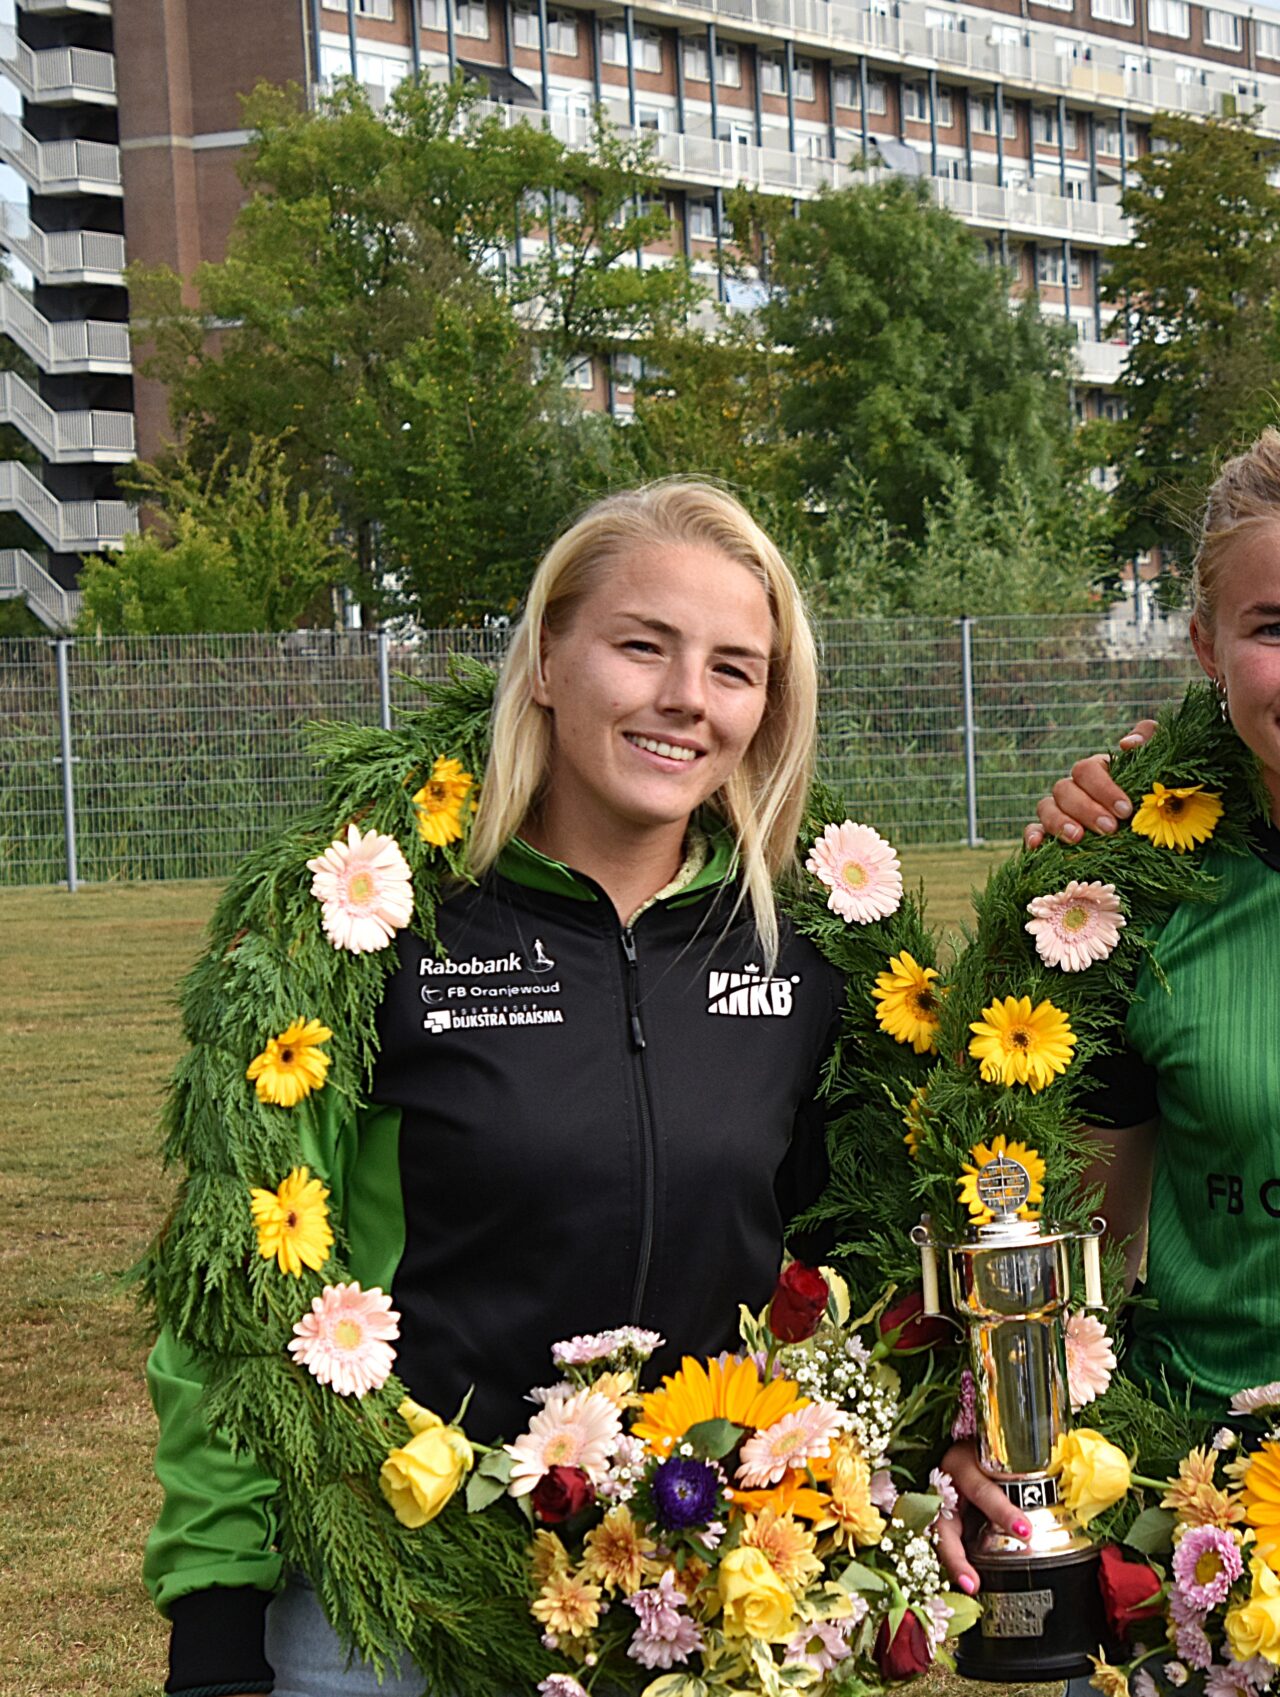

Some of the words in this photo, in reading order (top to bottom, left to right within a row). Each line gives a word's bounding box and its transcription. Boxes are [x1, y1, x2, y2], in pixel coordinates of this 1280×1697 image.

[419, 952, 522, 976] Rabobank
[447, 986, 467, 998] FB
[470, 981, 560, 998] Oranjewoud
[708, 971, 793, 1017] KNKB
[508, 1009, 564, 1026] DRAISMA
[1206, 1173, 1244, 1215] FB
